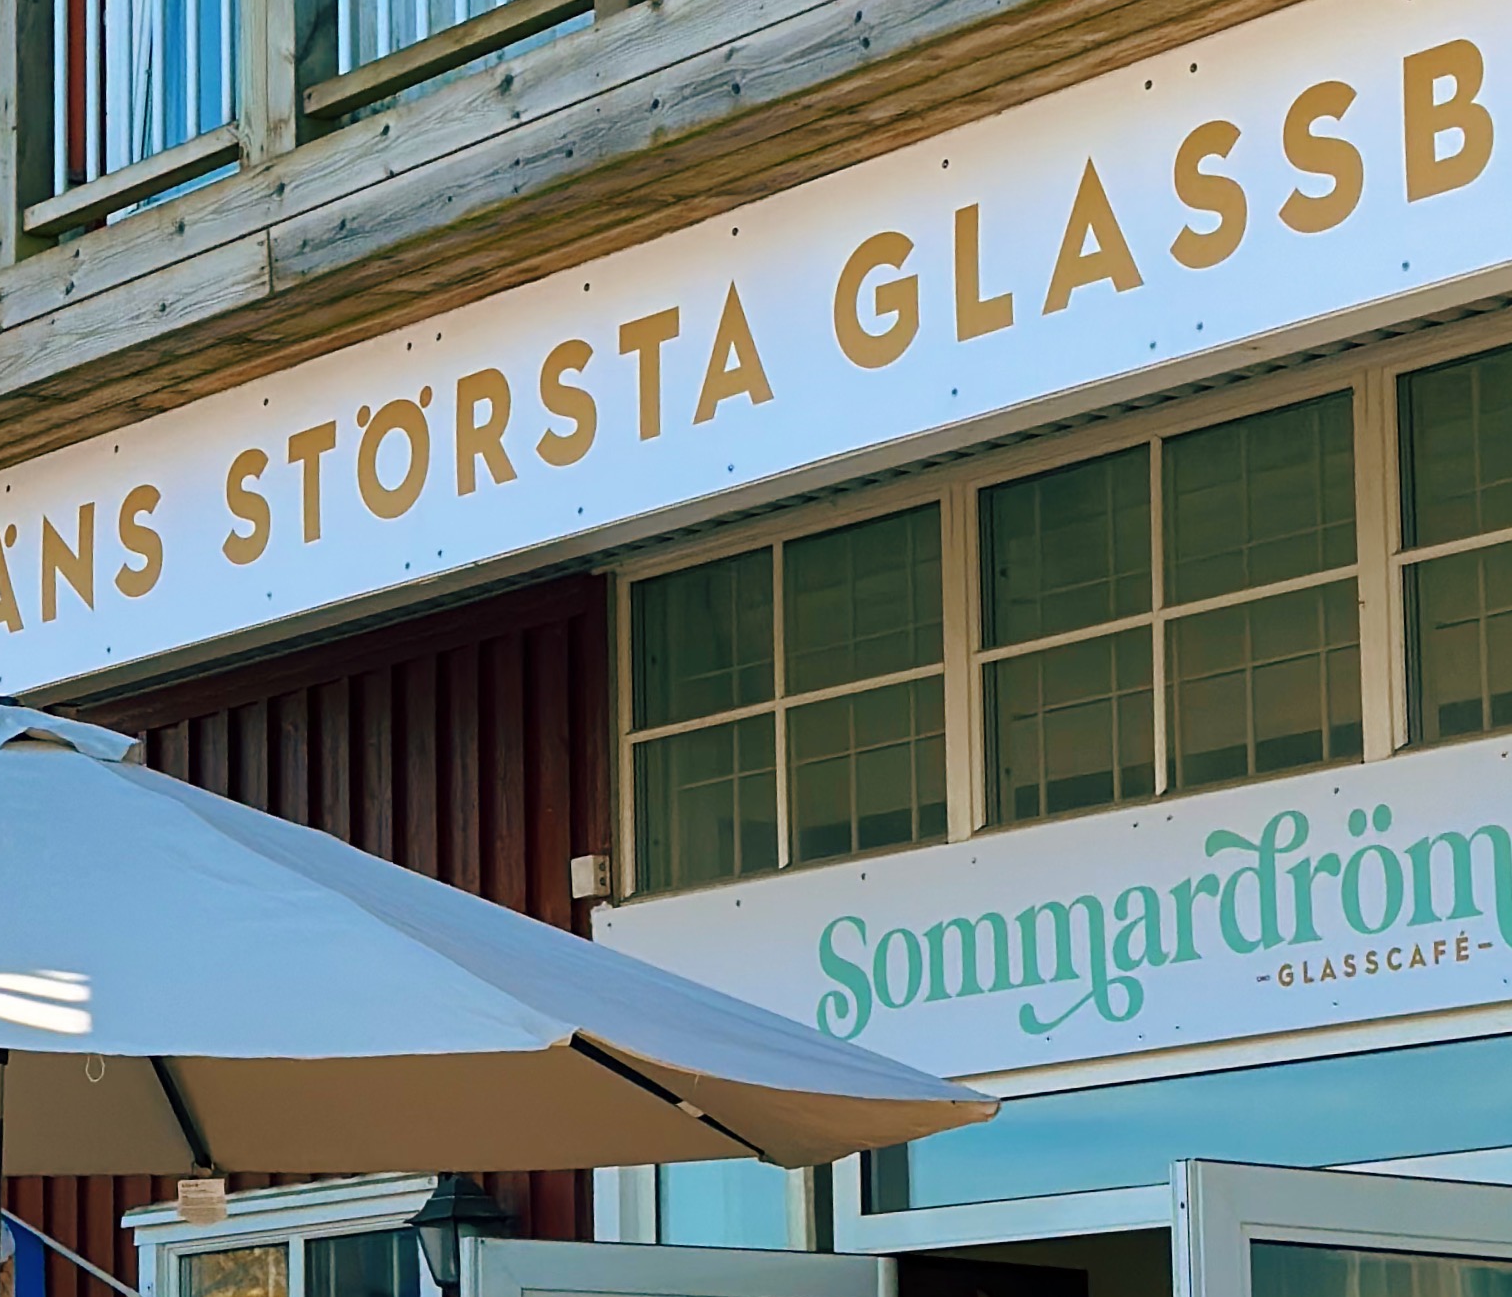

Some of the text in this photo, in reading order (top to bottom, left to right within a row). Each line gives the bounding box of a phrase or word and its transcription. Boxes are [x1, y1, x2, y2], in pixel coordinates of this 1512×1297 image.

[223, 280, 775, 566] STÖRSTA
[833, 38, 1495, 370] GLASSB
[816, 803, 1512, 1041] Sommardröm
